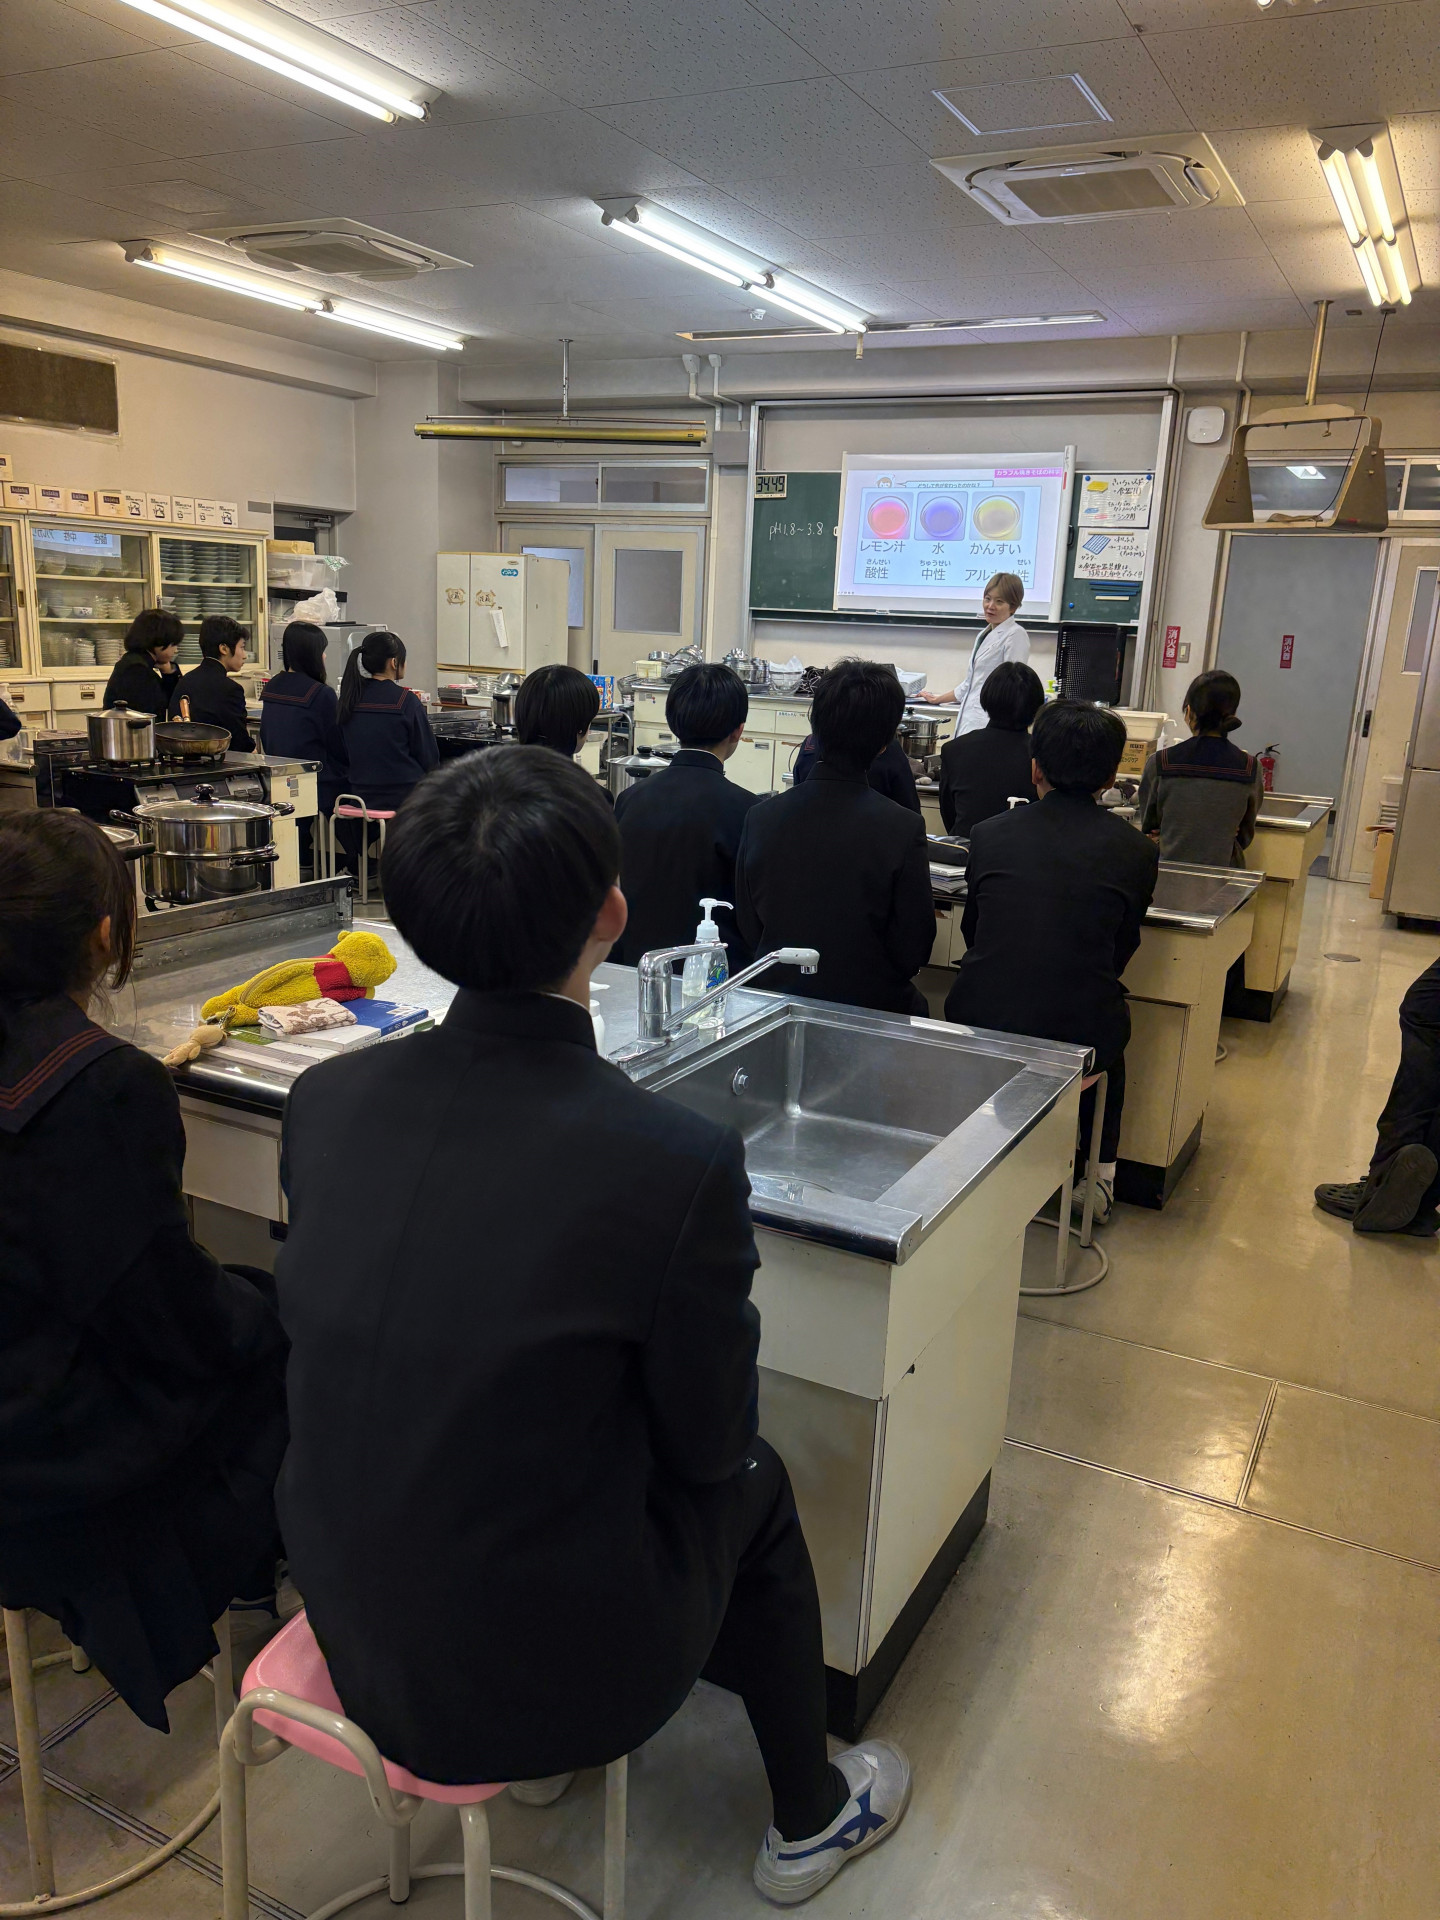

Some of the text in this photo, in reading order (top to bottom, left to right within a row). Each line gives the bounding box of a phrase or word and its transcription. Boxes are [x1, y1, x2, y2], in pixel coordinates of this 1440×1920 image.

[860, 540, 906, 553] レモン汁
[932, 542, 945, 555] 水
[969, 542, 1022, 555] かんすい
[864, 566, 889, 579] 酸性
[921, 568, 946, 581] 中性
[1165, 629, 1178, 658] 消火器
[1282, 637, 1293, 660] 消火器
